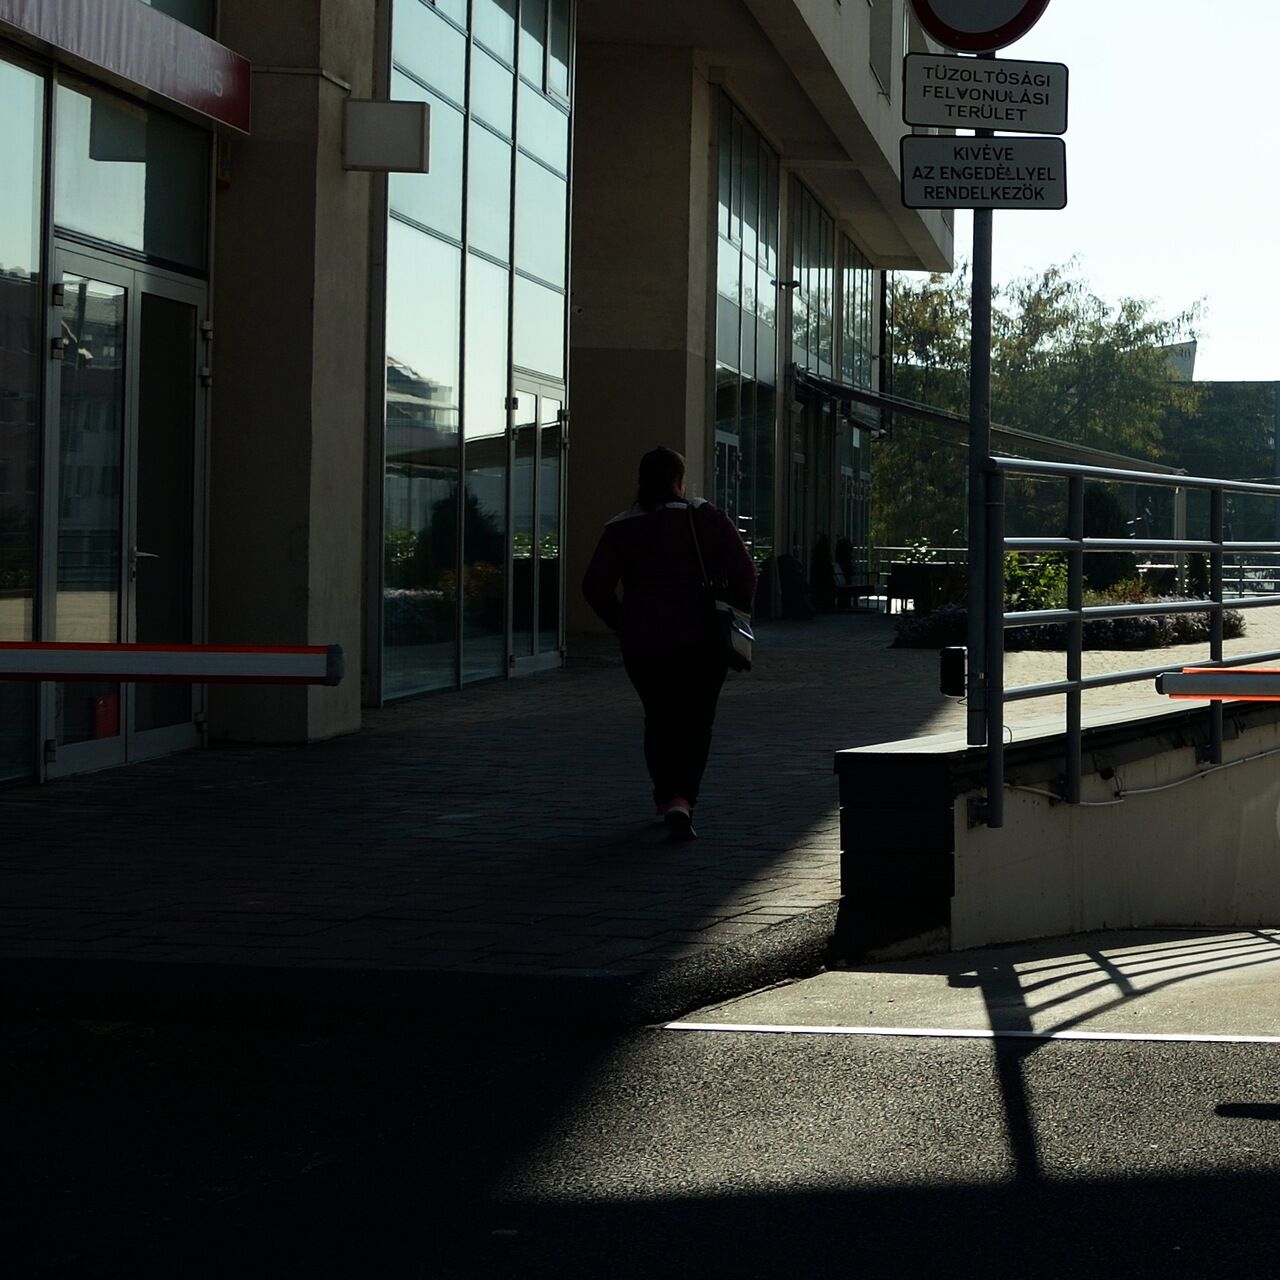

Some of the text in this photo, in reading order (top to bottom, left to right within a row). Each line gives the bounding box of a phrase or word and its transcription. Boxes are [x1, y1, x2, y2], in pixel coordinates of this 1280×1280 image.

[922, 85, 1049, 105] FELVONULÁSI
[944, 104, 1028, 121] TERÜLET
[954, 144, 1014, 161] KIVÉVE
[912, 164, 1056, 181] AZ ENGEDÉLLYEL
